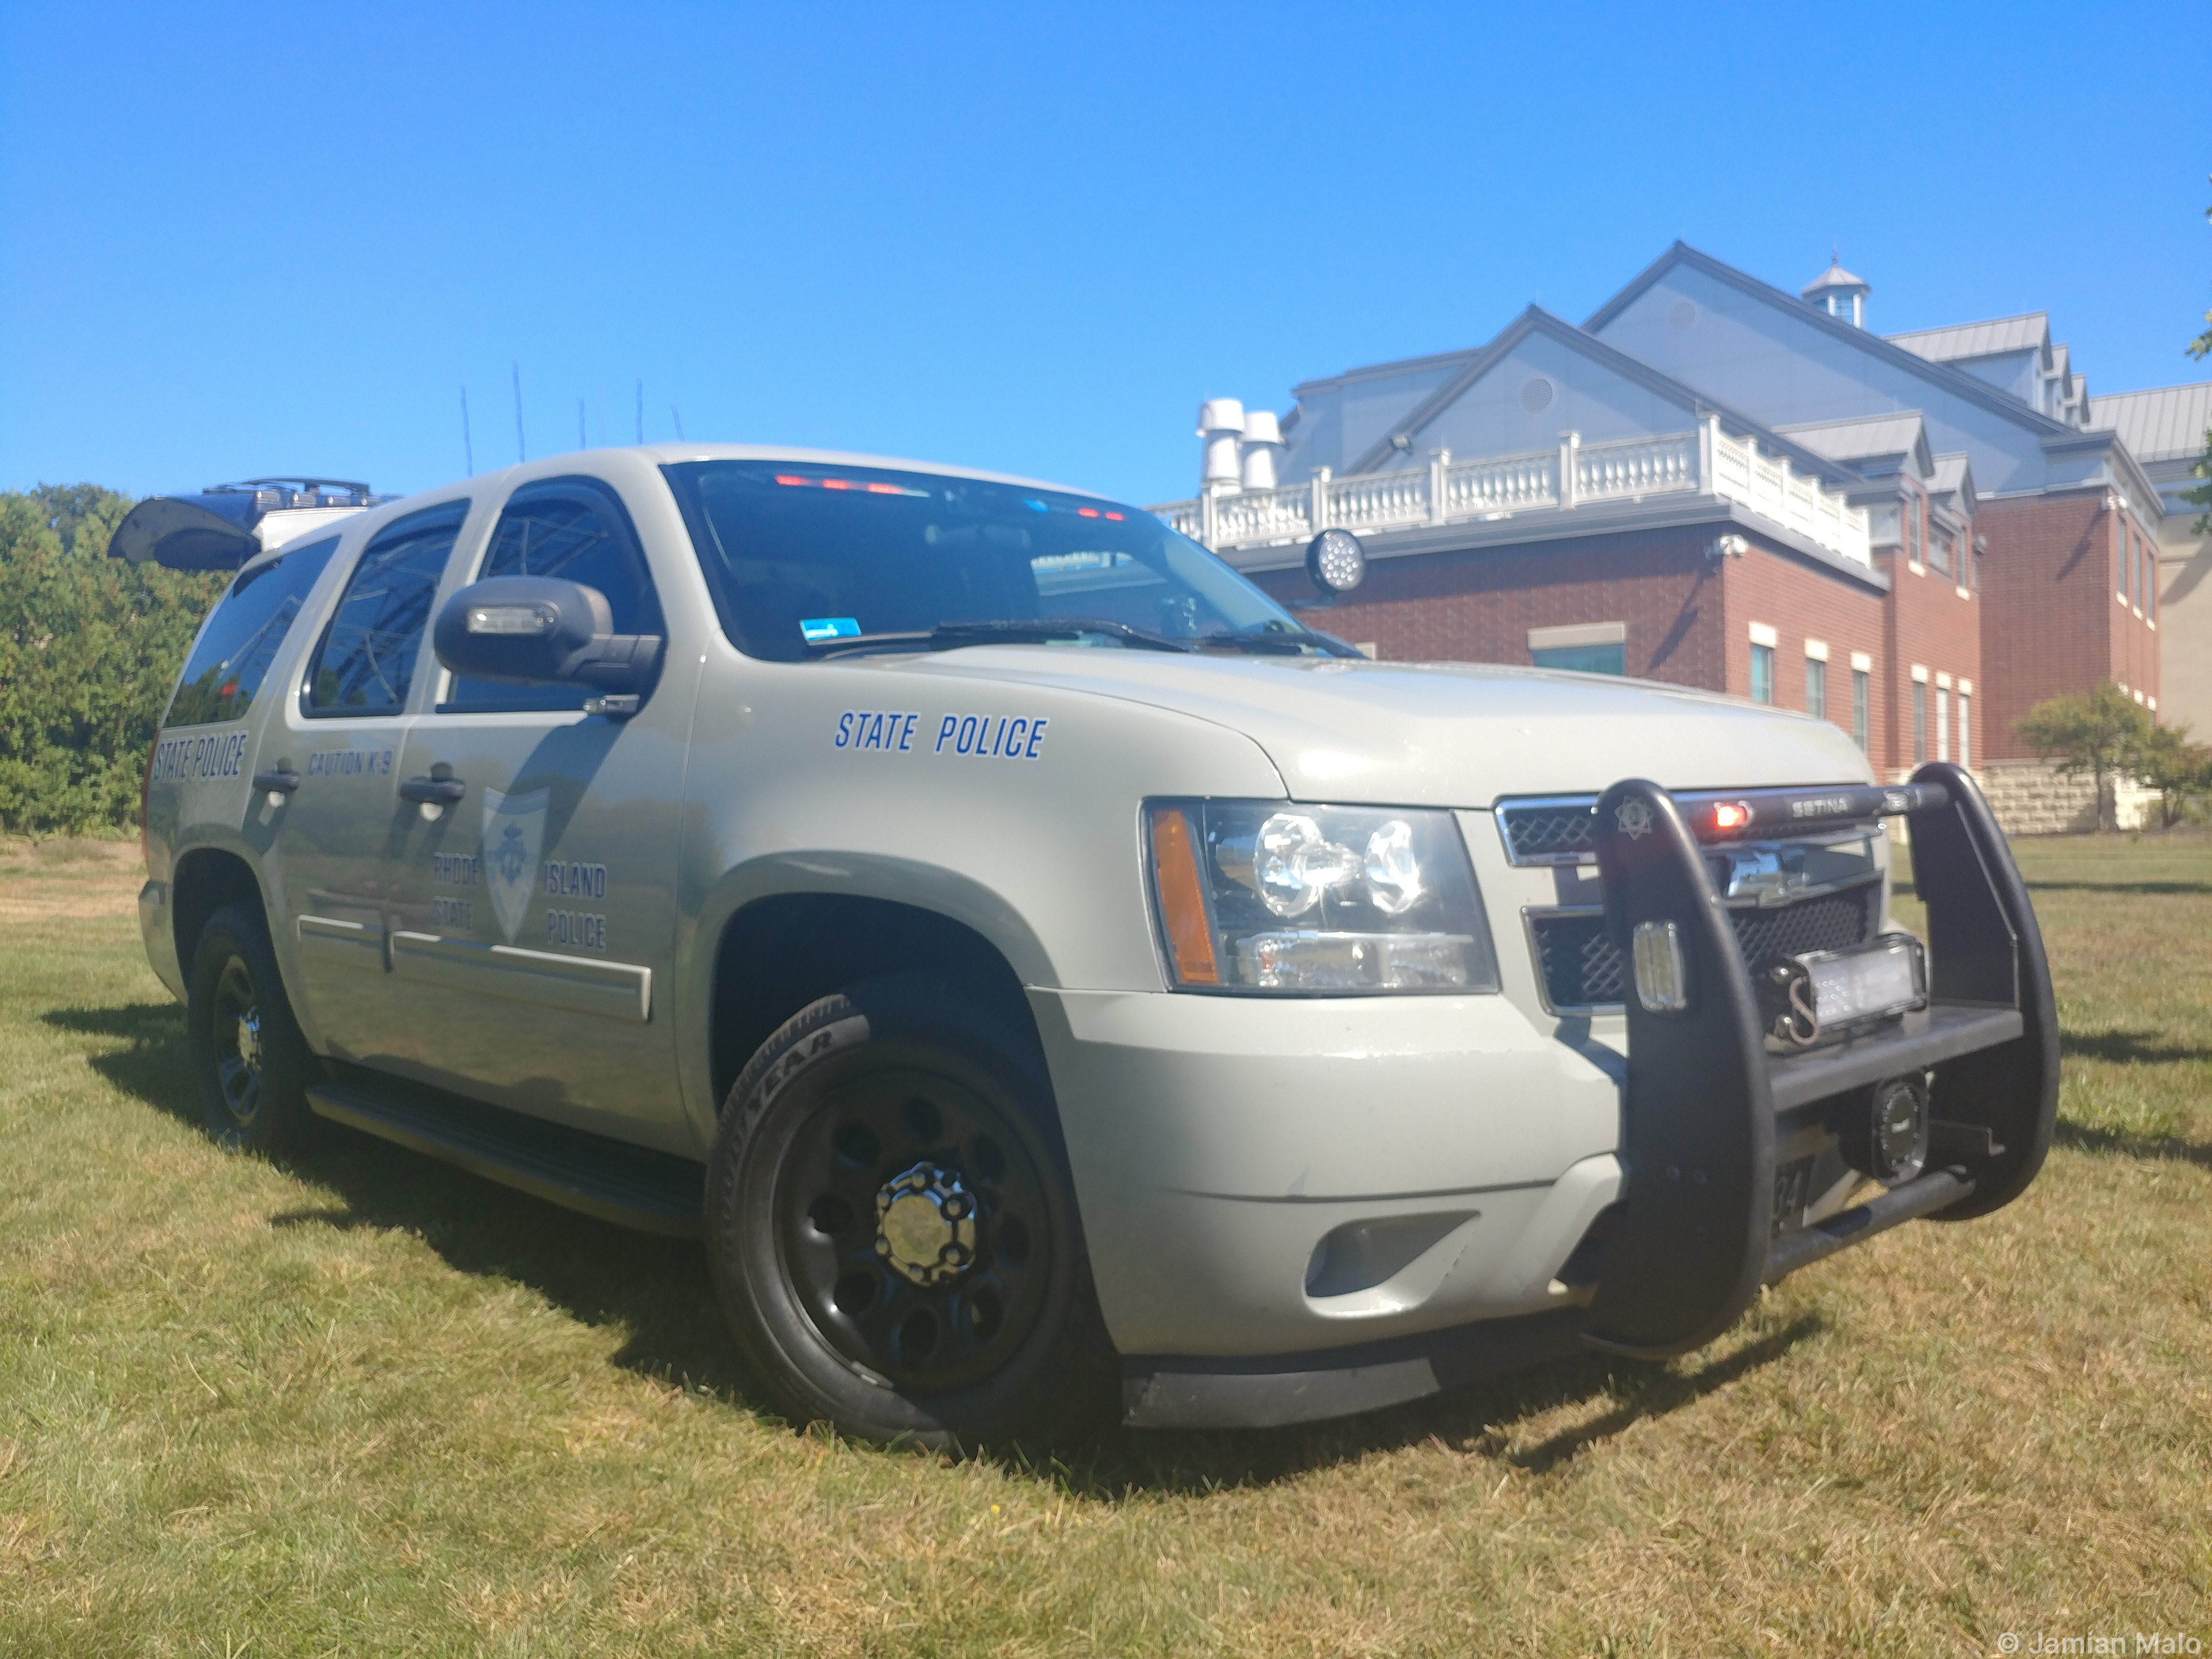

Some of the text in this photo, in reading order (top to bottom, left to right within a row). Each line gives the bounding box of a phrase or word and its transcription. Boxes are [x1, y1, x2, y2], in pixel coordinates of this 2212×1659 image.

[153, 733, 247, 781] STATE POLICE
[834, 712, 1048, 759] STATE POLICE
[307, 751, 365, 776] CAUTION
[433, 854, 606, 899] RHODE ISLAND
[433, 898, 605, 949] STATE POLICE
